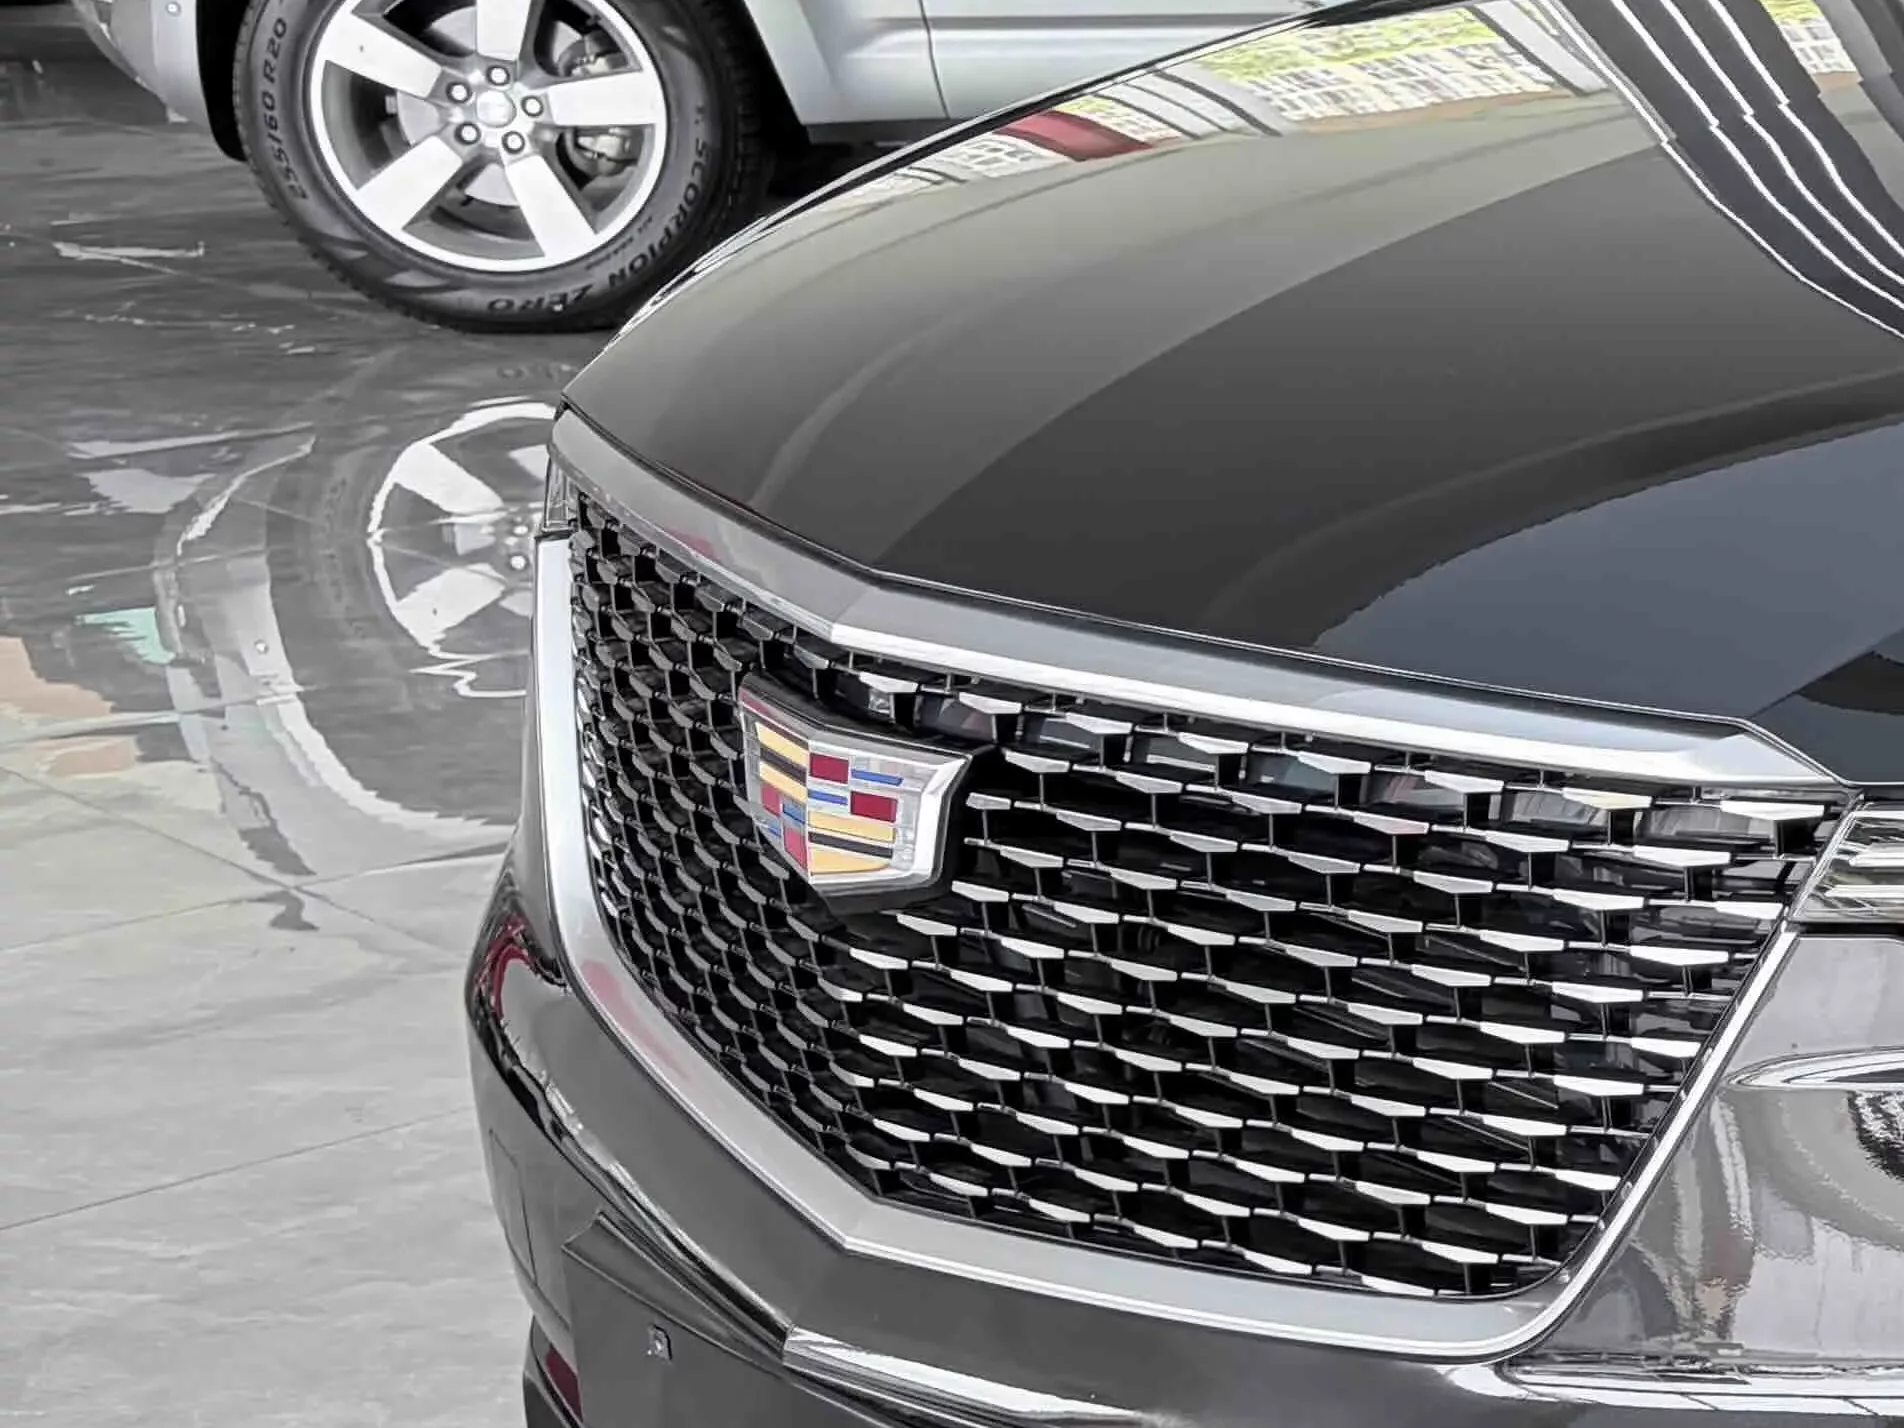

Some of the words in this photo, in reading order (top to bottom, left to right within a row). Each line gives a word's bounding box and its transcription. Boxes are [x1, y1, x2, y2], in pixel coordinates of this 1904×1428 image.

[262, 17, 288, 84] R20
[260, 89, 309, 200] 255/60
[608, 138, 711, 289] SCORPION
[487, 282, 593, 313] ZERO
